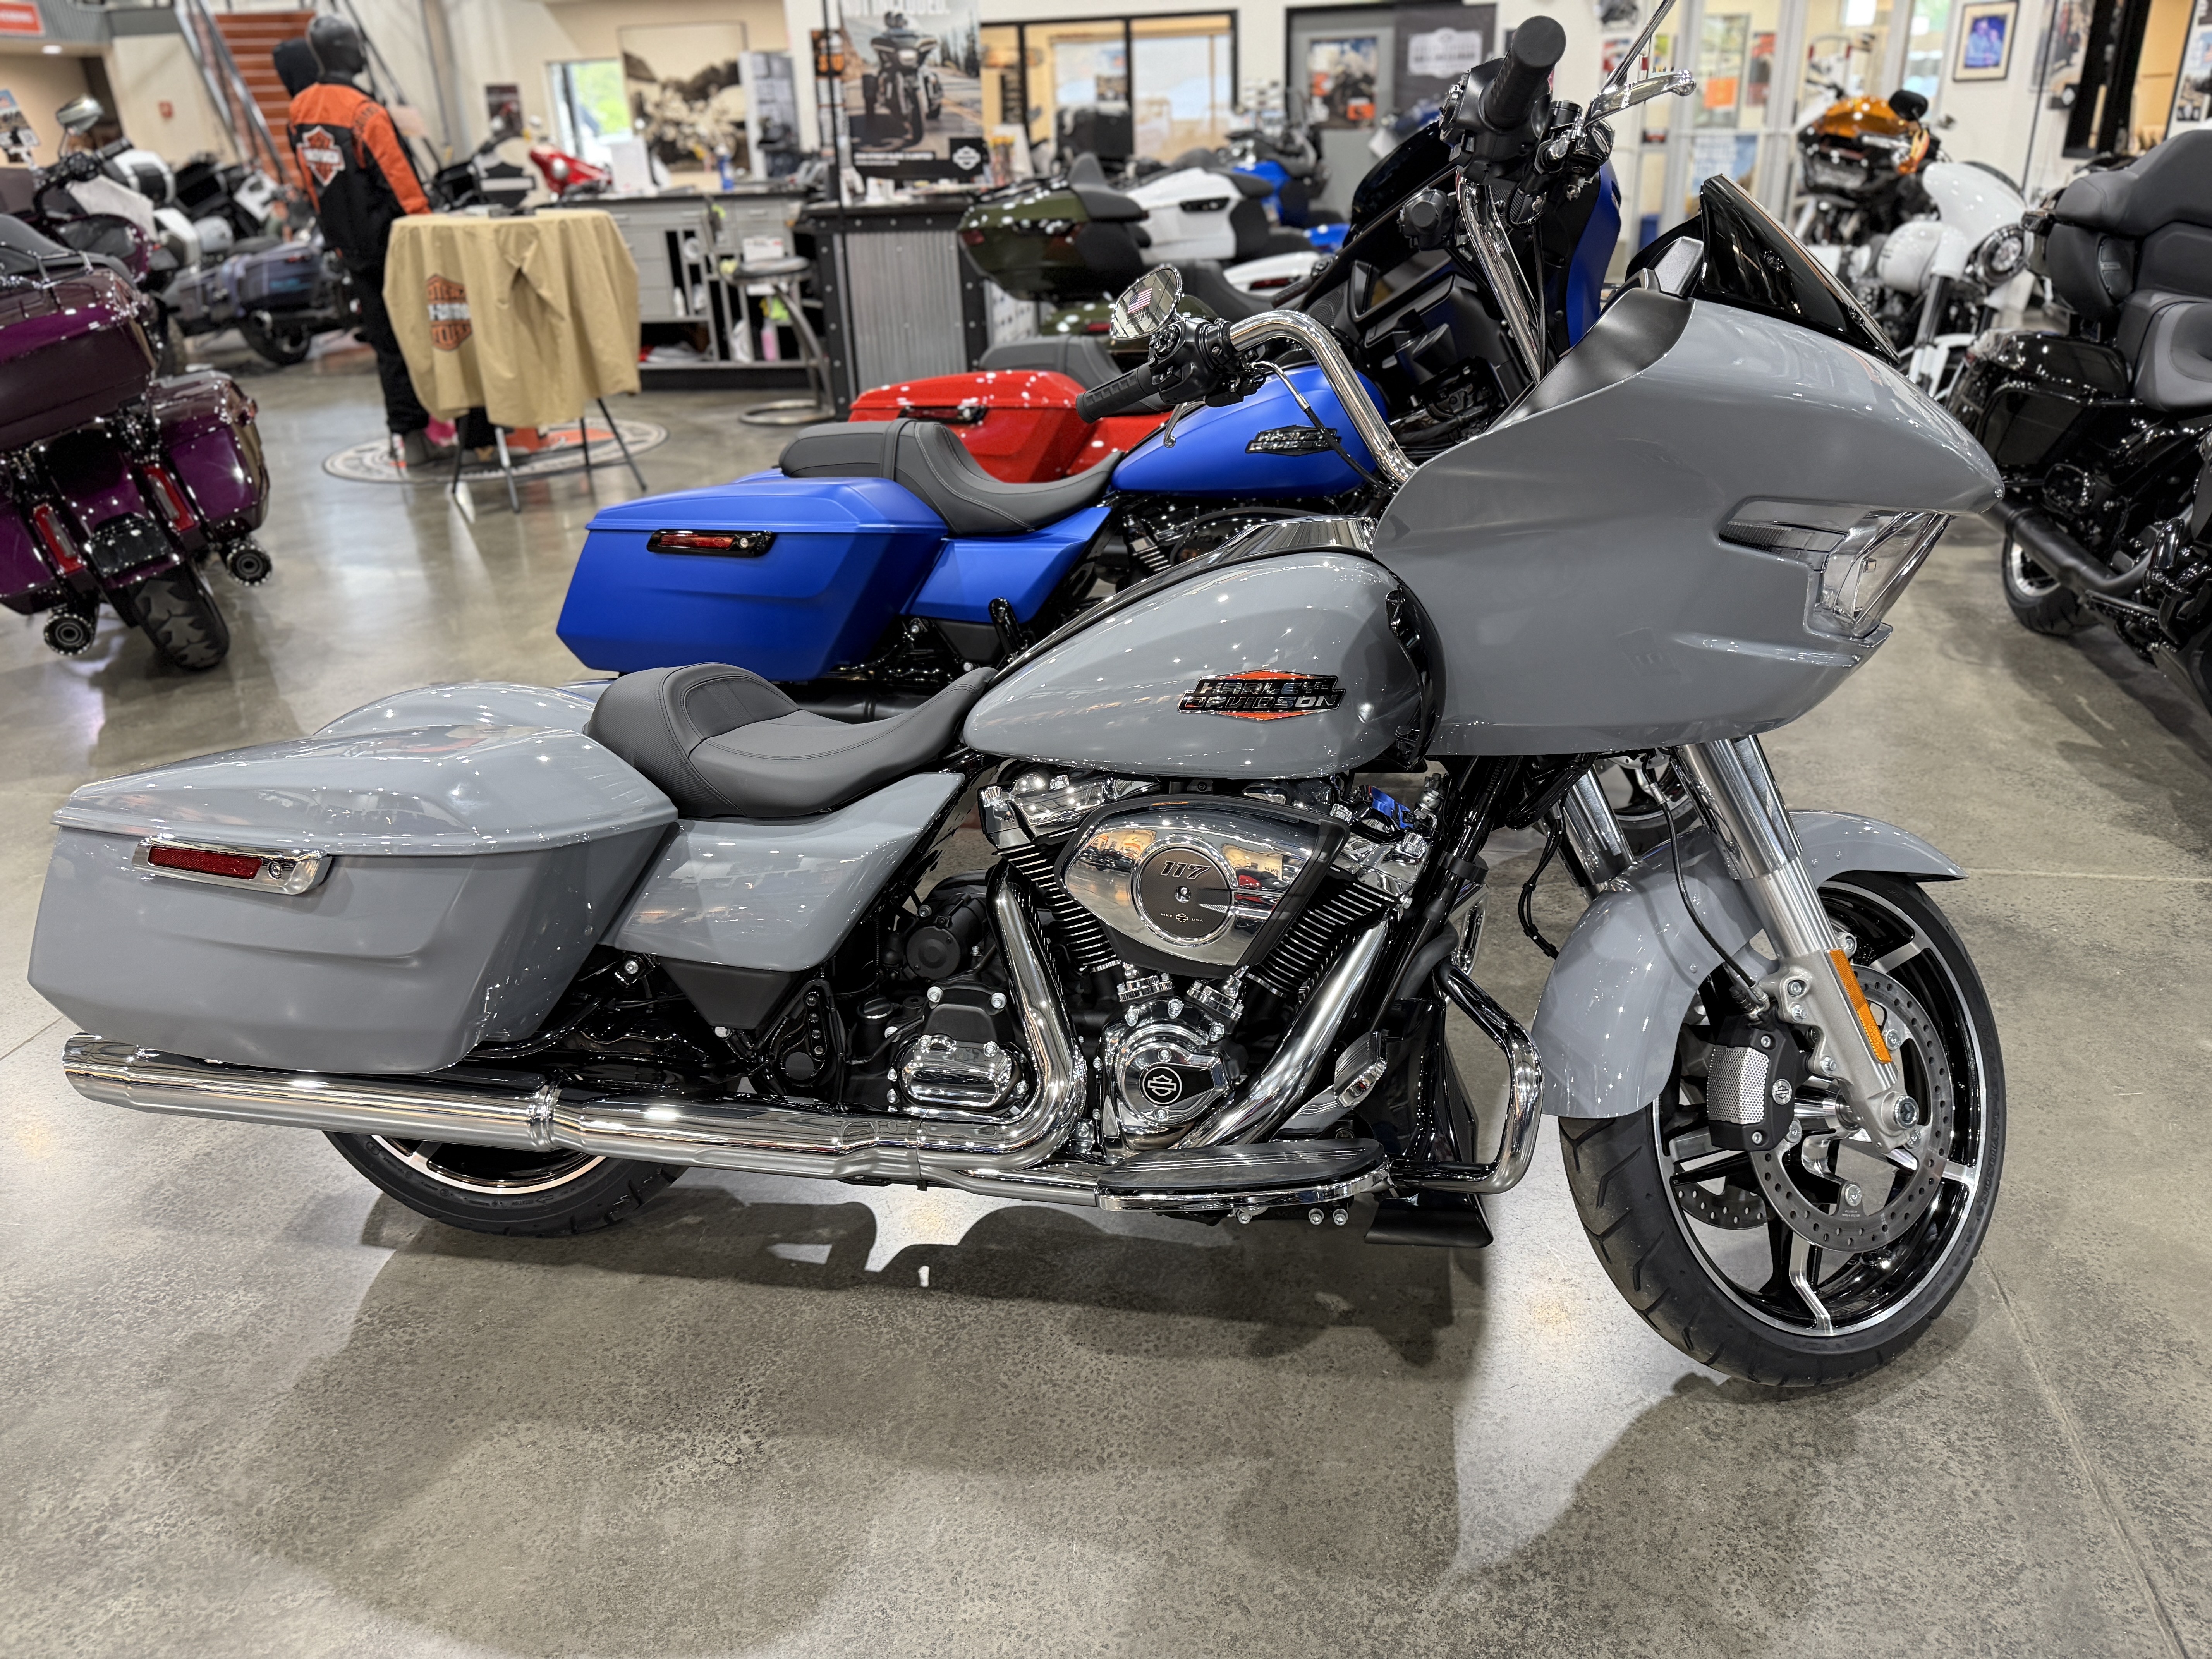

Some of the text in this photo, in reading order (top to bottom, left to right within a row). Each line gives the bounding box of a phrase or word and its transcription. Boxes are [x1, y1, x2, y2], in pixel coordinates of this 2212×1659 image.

[1249, 440, 1329, 450] DAVIDSO
[1185, 695, 1336, 708] DAVIDSON
[1161, 861, 1211, 879] 117
